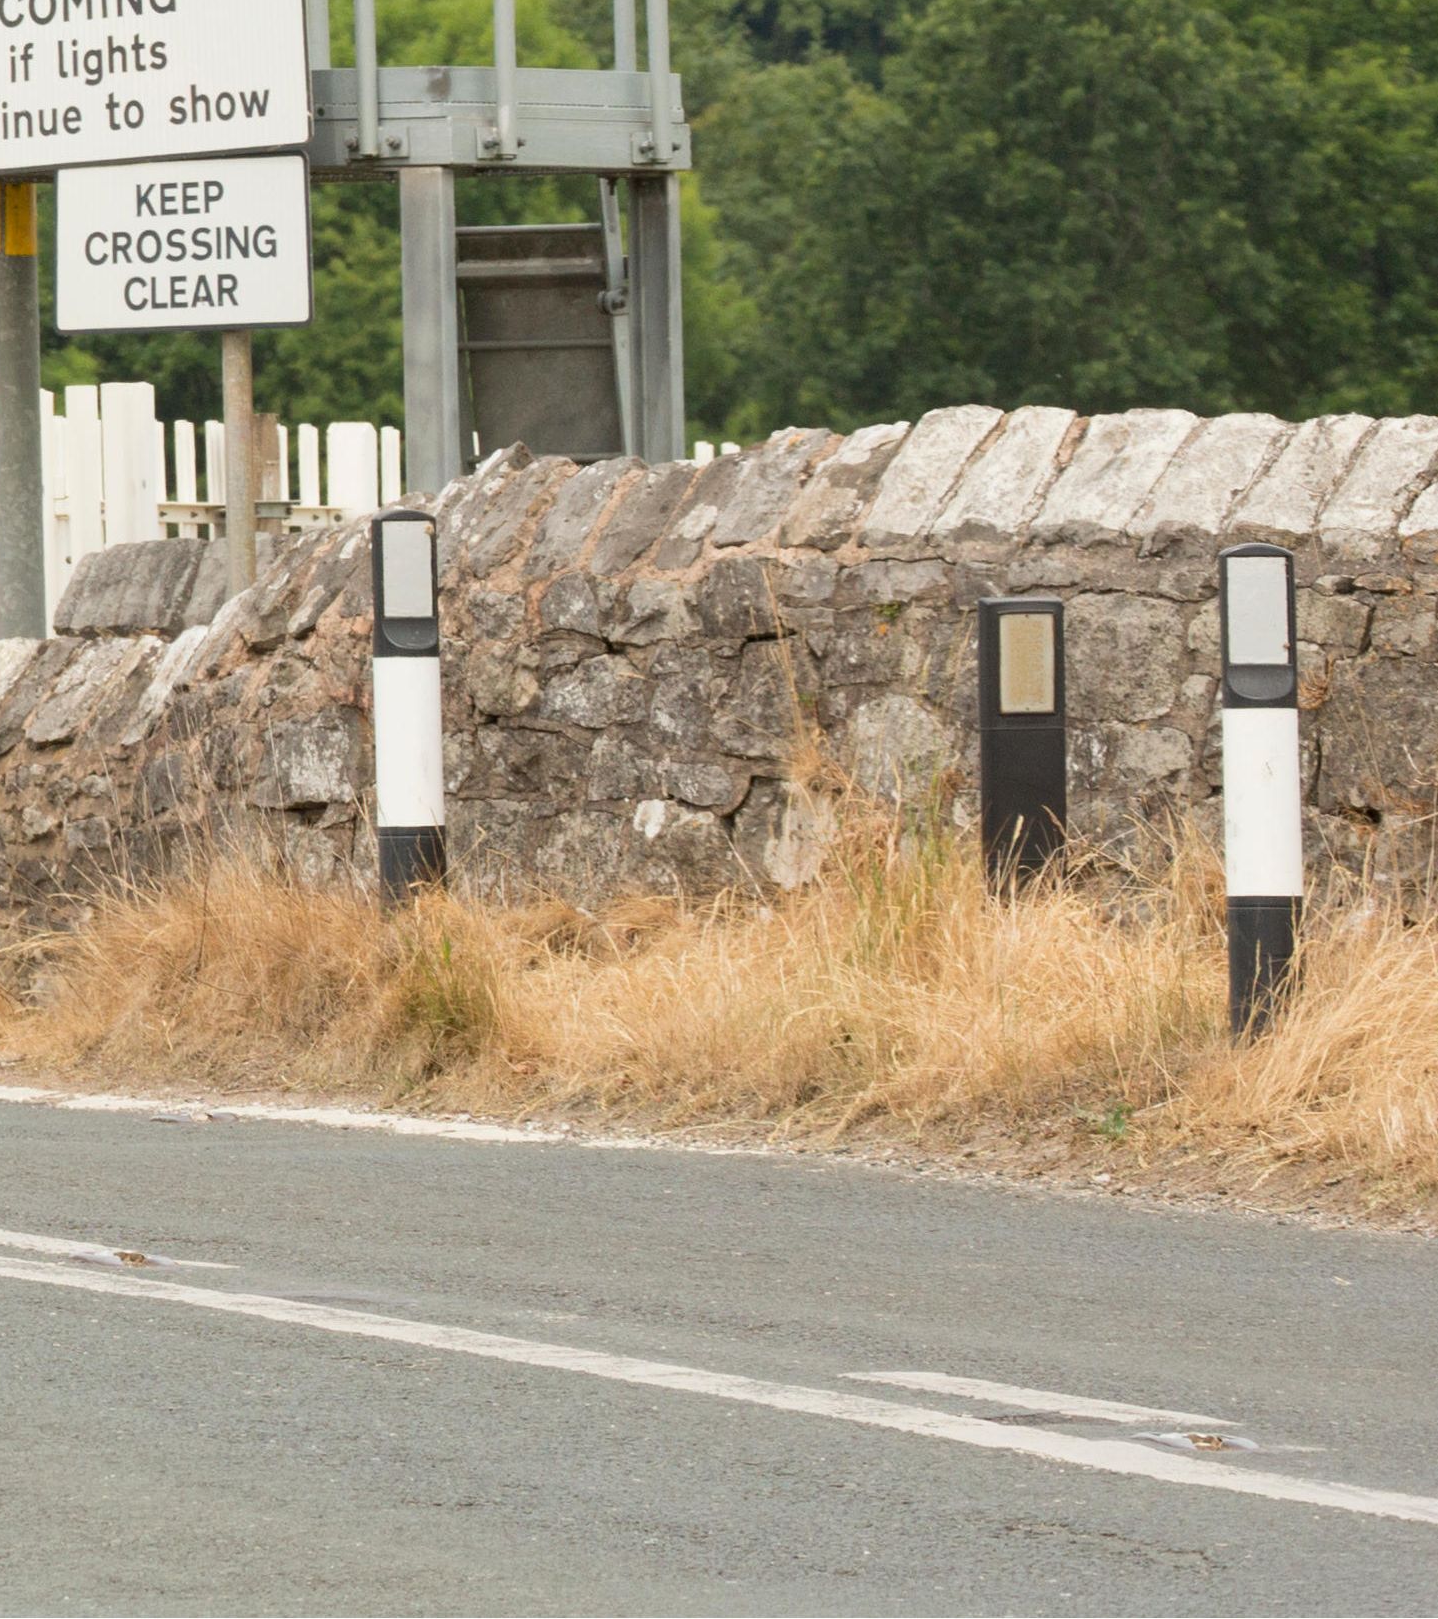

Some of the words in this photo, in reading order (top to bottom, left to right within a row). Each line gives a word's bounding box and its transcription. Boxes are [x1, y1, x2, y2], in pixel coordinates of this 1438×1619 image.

[10, 43, 33, 83] if
[58, 34, 167, 86] lights
[106, 93, 144, 130] to
[170, 84, 269, 124] show
[136, 181, 223, 217] KEEP
[85, 225, 277, 265] CROSSING
[124, 274, 238, 311] CLEAR
